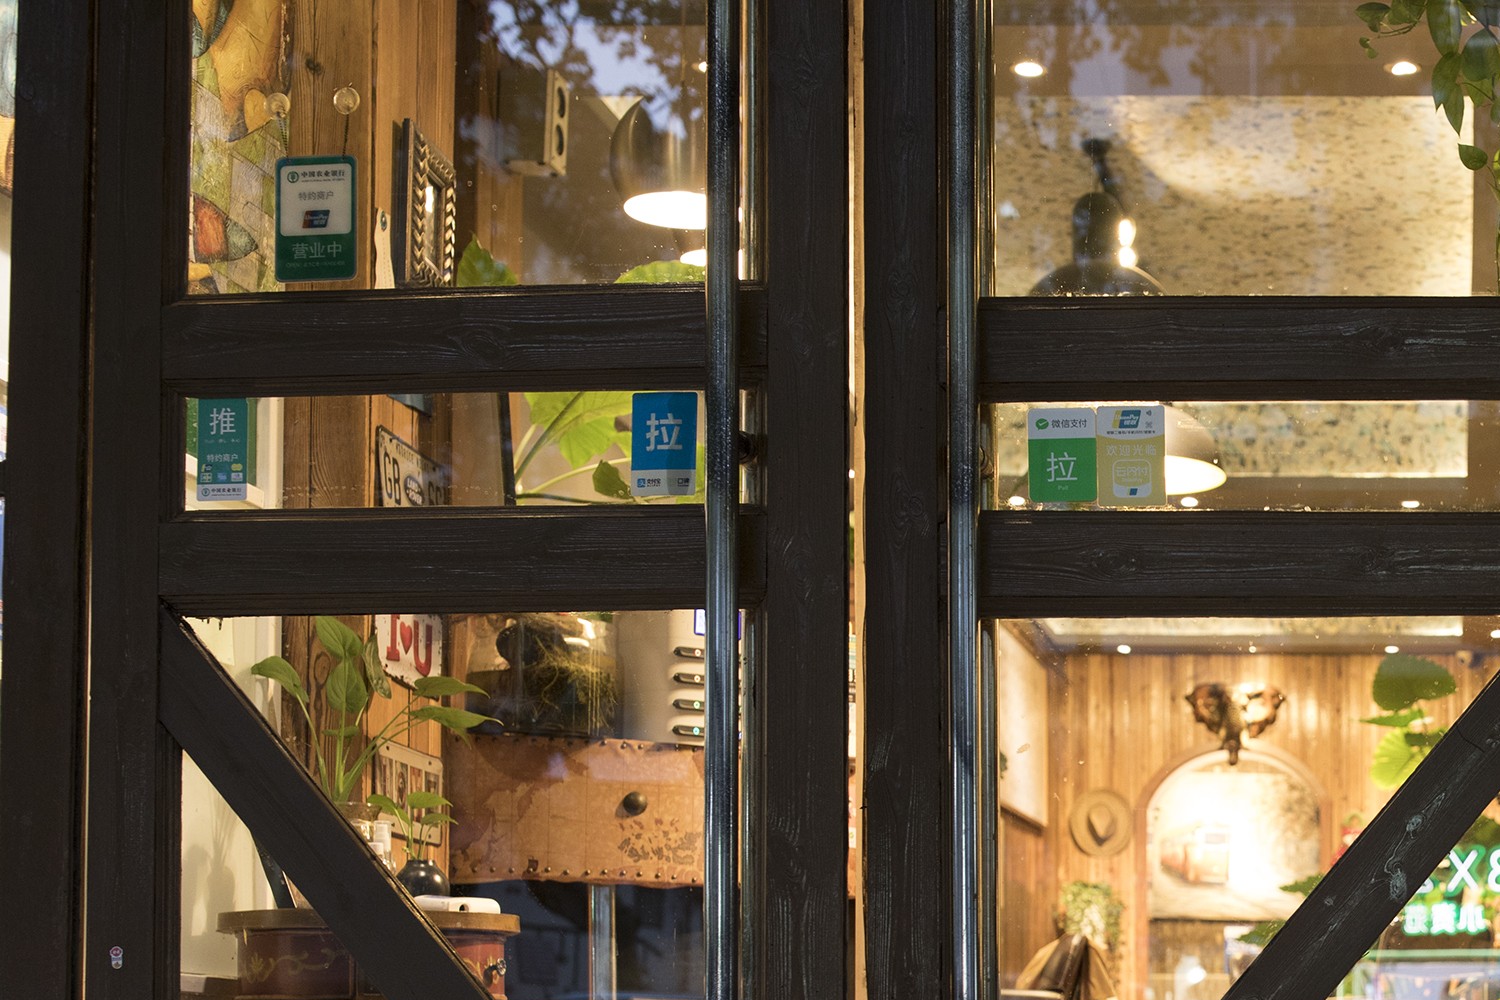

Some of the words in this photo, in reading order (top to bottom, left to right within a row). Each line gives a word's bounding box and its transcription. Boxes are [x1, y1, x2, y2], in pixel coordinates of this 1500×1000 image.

[298, 190, 334, 201] 特约商户
[292, 241, 342, 259] 营业中
[210, 407, 236, 435] 推
[1051, 418, 1088, 429] 微信支付
[646, 413, 683, 452] 拉
[1107, 444, 1157, 456] 欢迎光临
[1046, 452, 1078, 482] 拉
